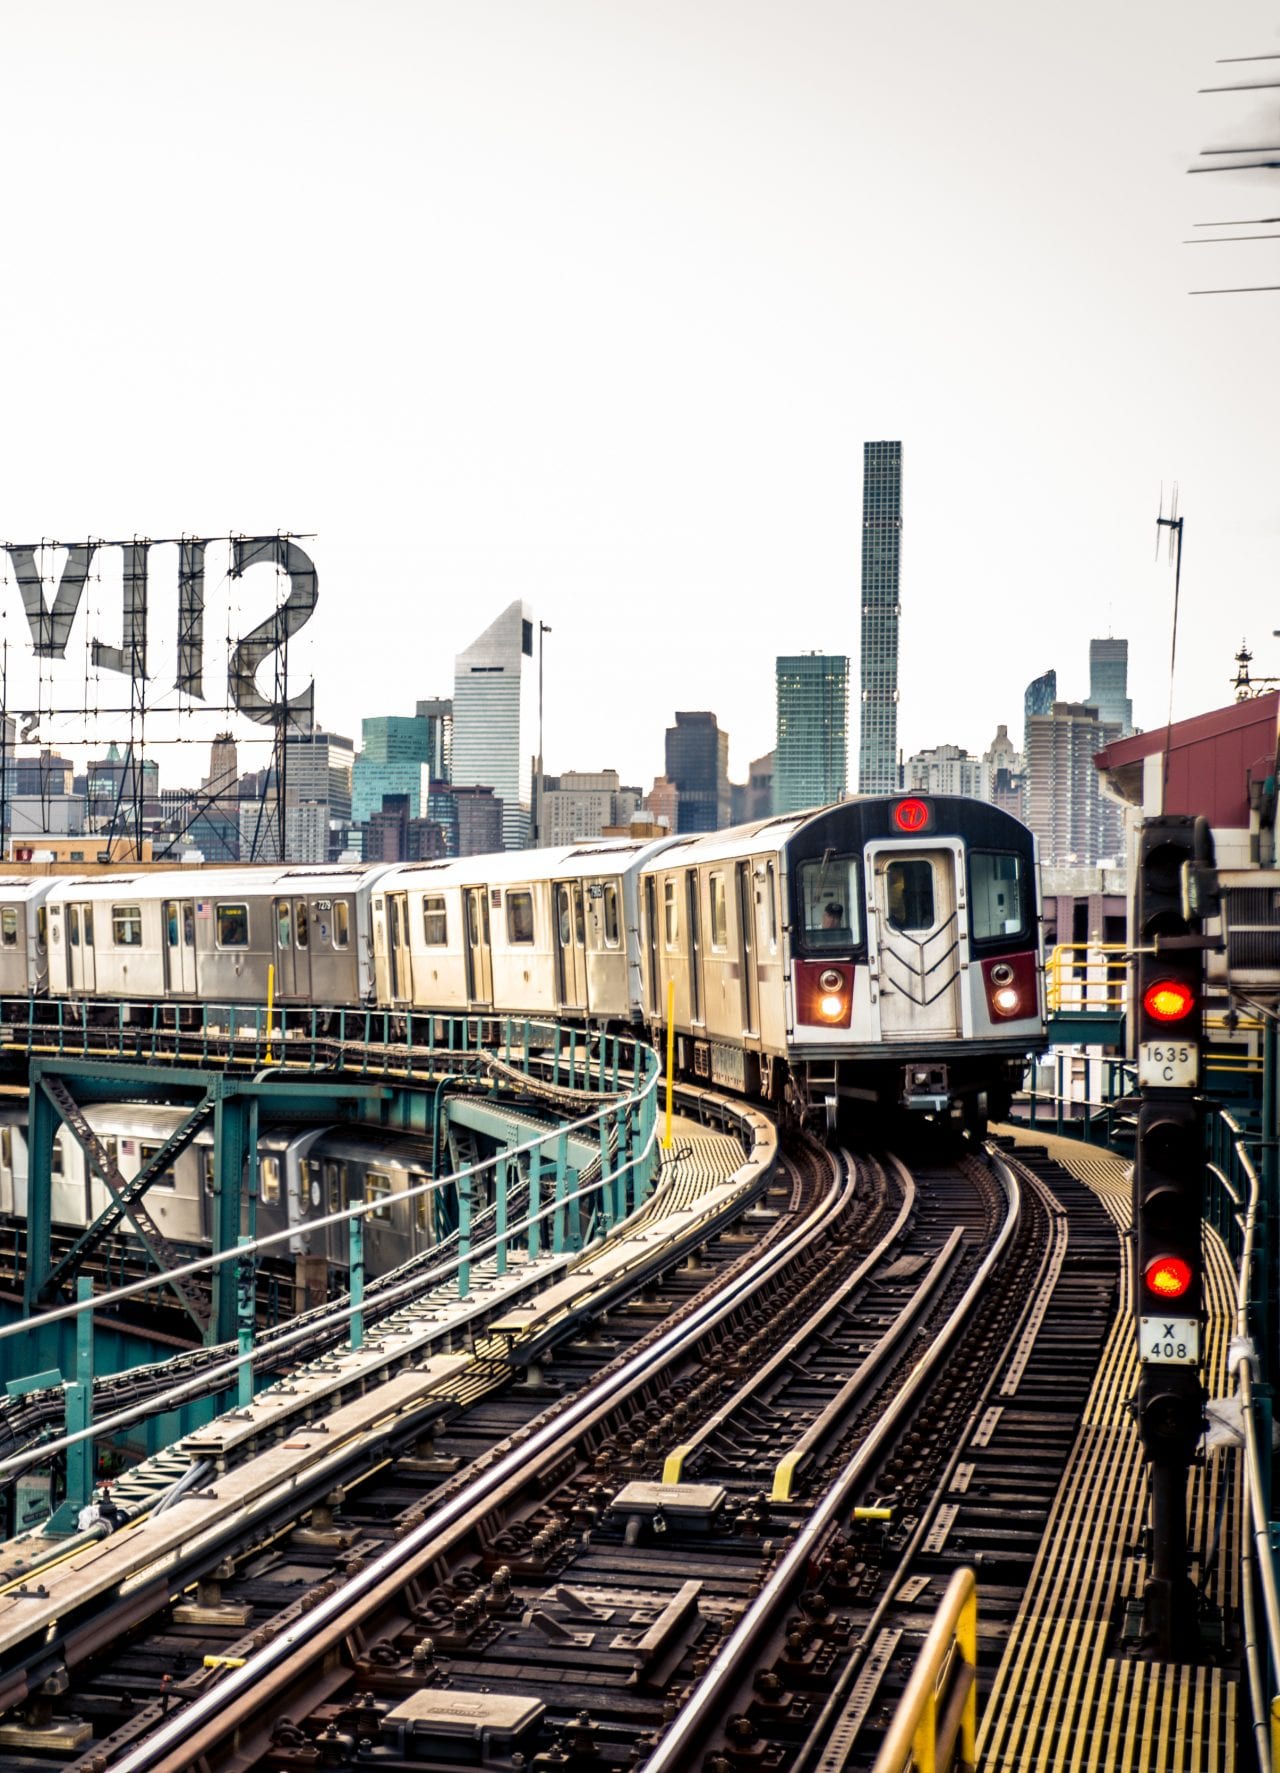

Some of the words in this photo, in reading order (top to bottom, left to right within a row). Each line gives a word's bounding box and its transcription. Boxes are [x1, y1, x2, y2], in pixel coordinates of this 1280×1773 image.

[1147, 1047, 1189, 1063] 1635
[1162, 1066, 1174, 1082] C
[1162, 1323, 1176, 1340] X
[1150, 1342, 1187, 1359] 408
